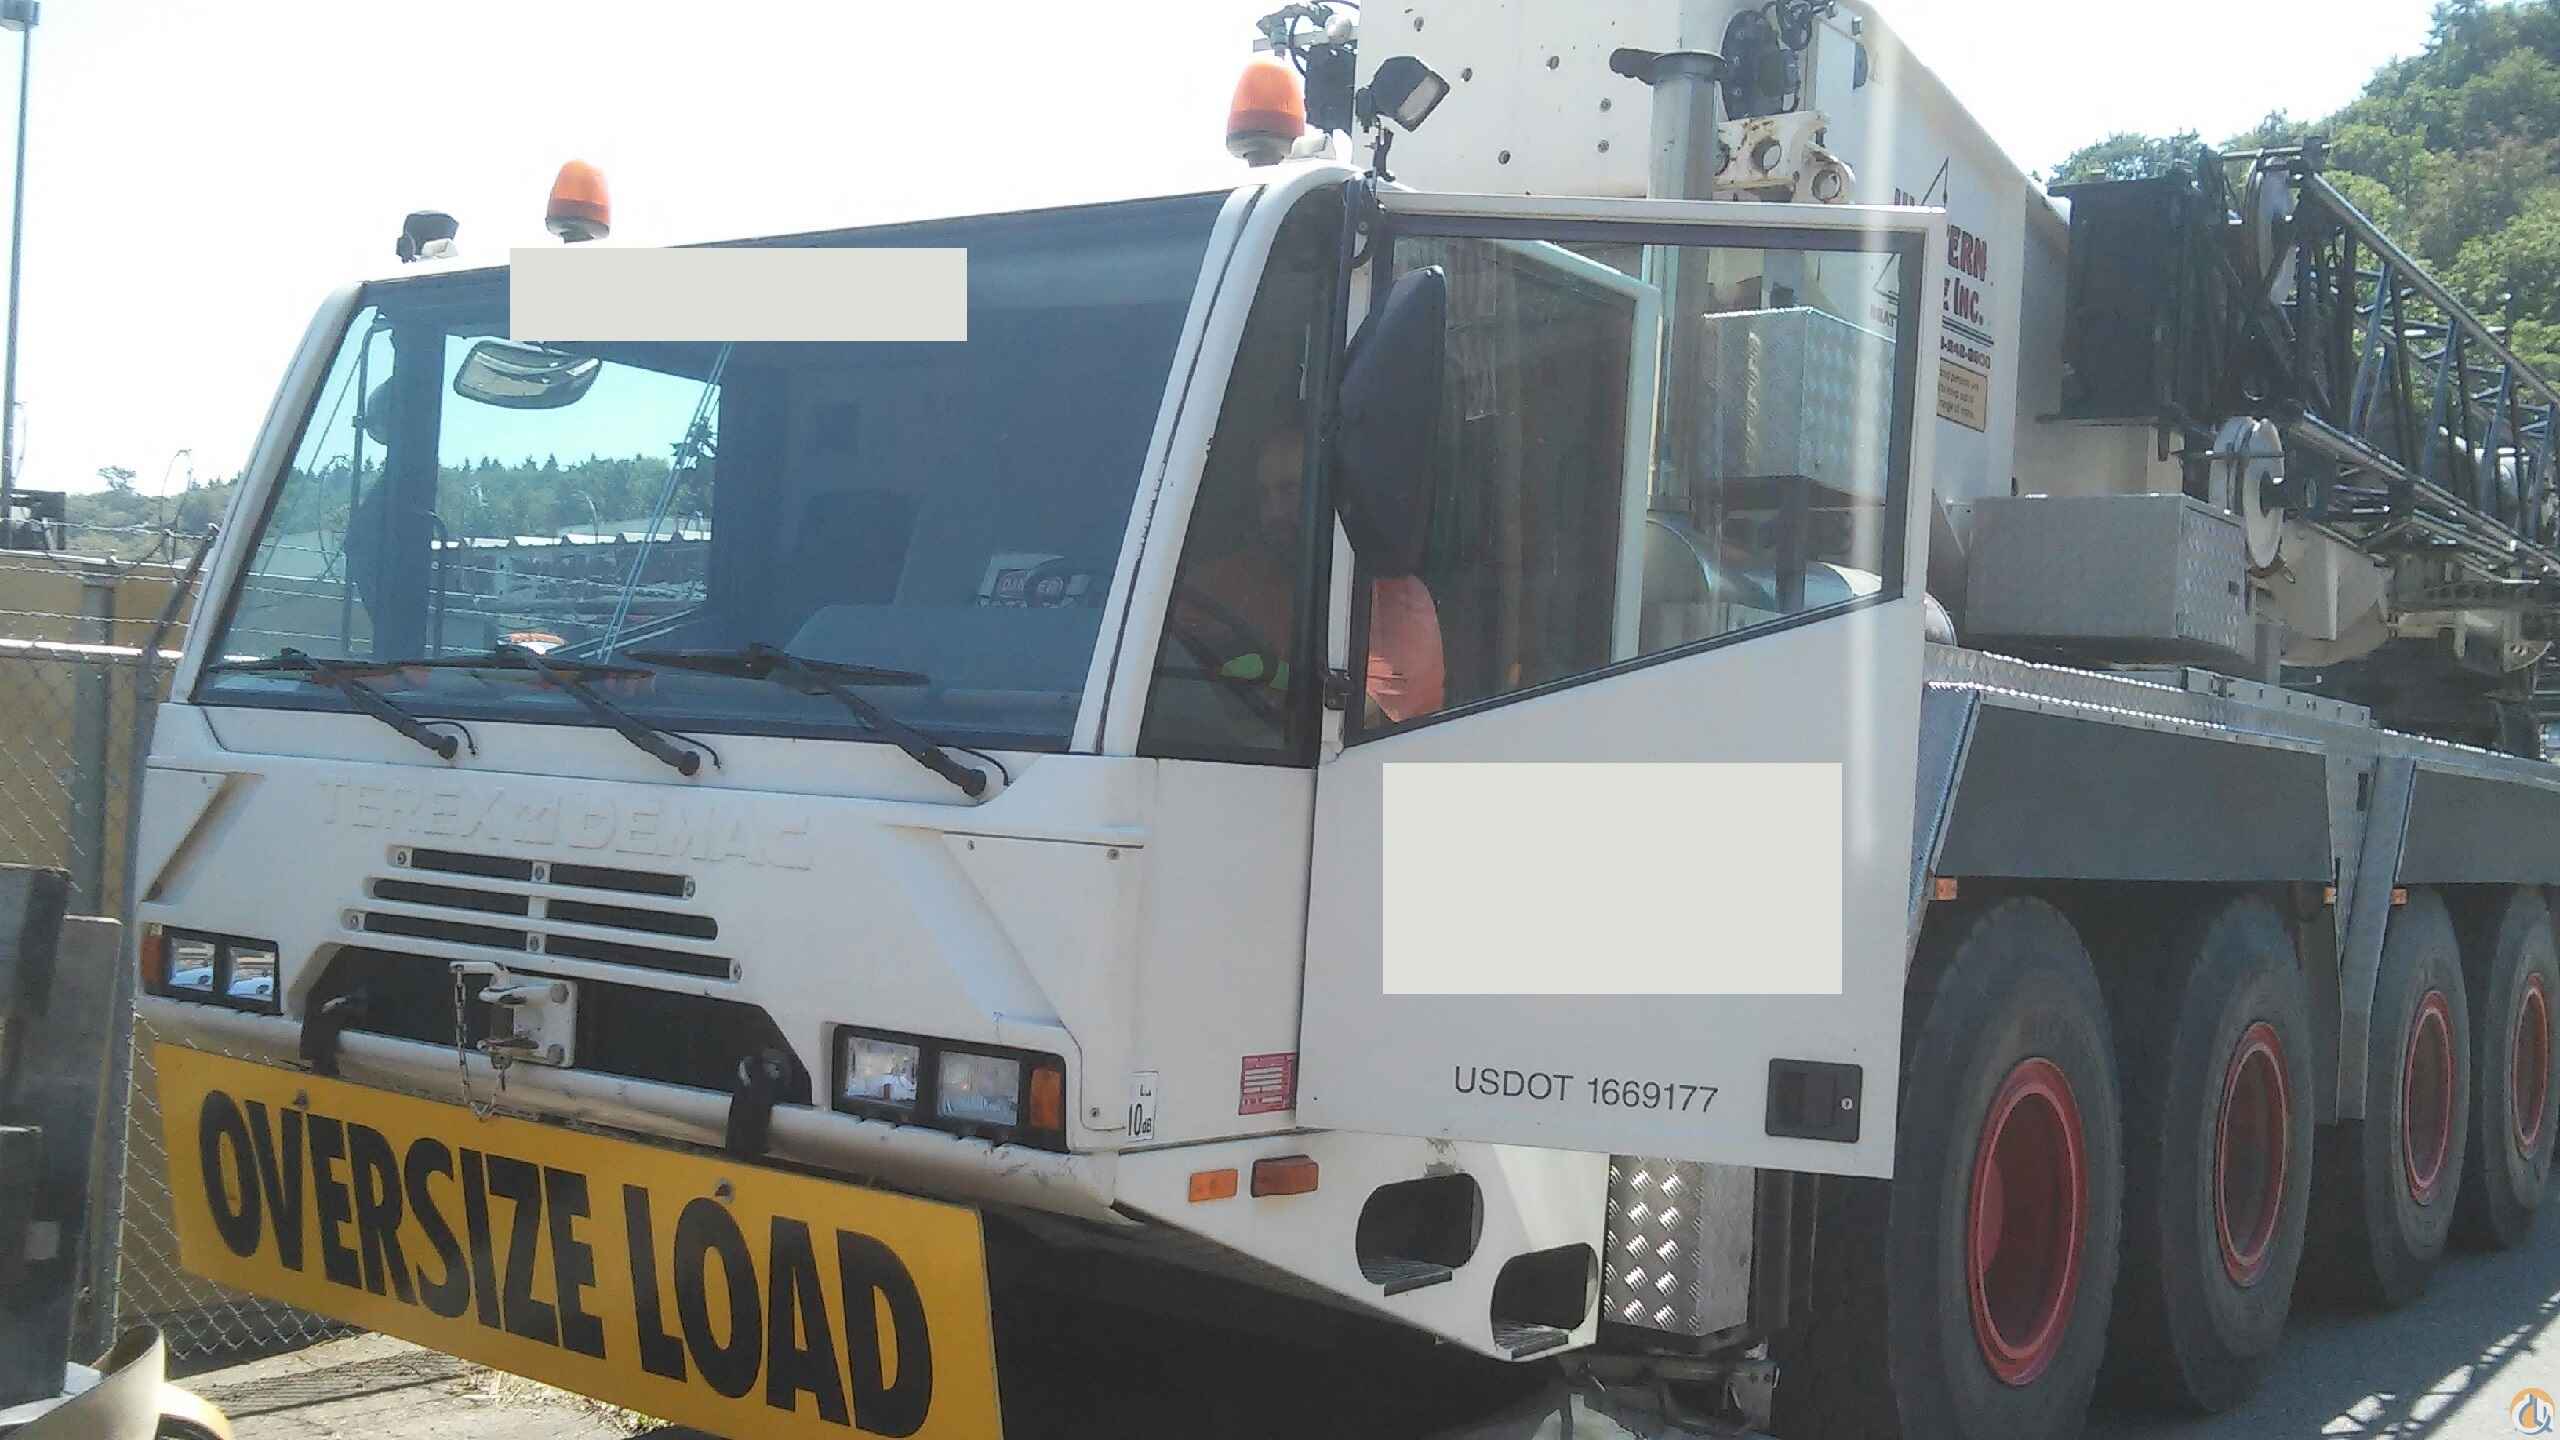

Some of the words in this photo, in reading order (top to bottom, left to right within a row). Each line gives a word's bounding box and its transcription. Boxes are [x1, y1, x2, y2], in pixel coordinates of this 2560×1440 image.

[1946, 224, 1987, 281] ERN
[1455, 1066, 1574, 1101] USDOT
[1588, 1077, 1719, 1113] 1669177
[199, 1089, 607, 1360] OVERSIZE
[621, 1183, 934, 1439] LOAD
